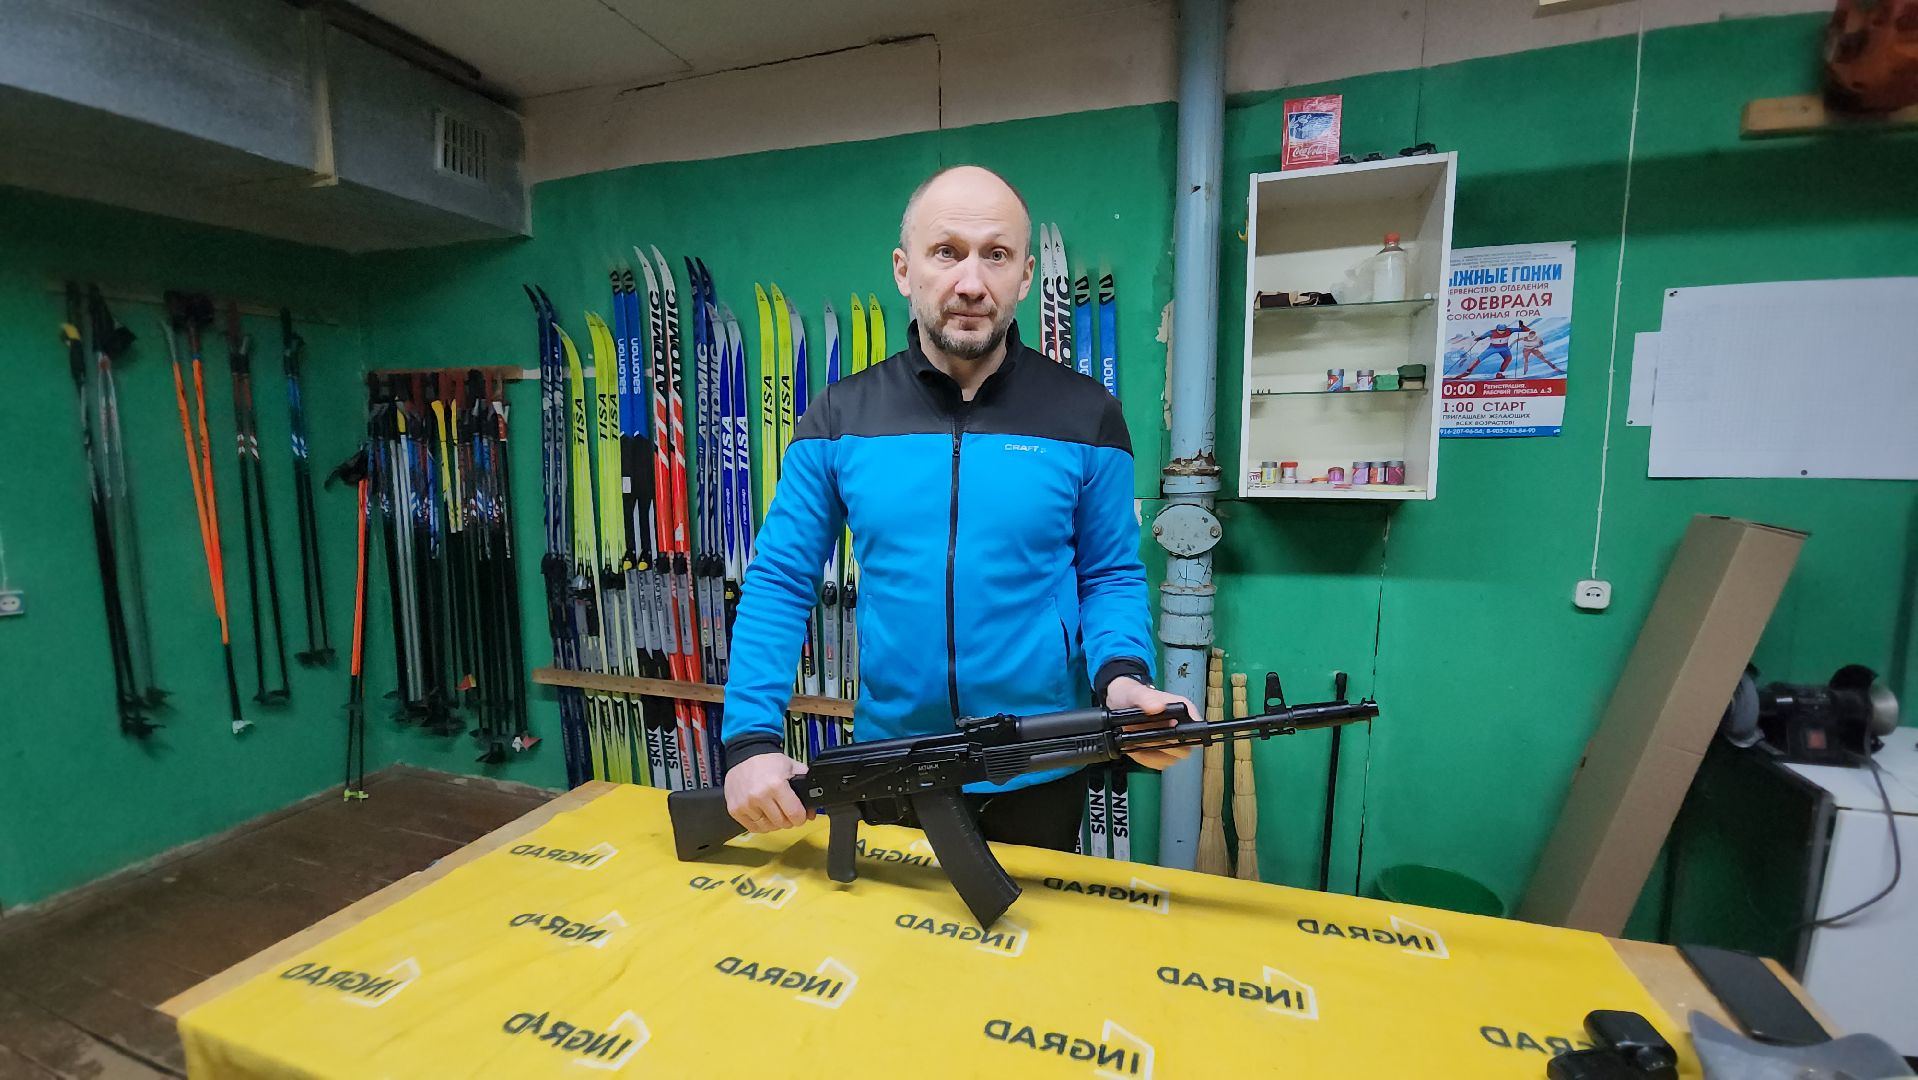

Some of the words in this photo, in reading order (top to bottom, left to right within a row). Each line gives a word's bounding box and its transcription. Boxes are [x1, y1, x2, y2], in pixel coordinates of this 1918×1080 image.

[1448, 286, 1496, 295] ЕРВЕНСТВО
[1500, 283, 1549, 293] ОТДЕЛЕНИЯ
[1449, 267, 1509, 287] ЫЖНЫЕ
[1512, 264, 1562, 283] ГОНКИ
[1043, 277, 1055, 358] OMIC
[1056, 275, 1071, 368] OMIC
[1447, 311, 1509, 321] СОКОЛИНАЯ
[1516, 309, 1540, 317] ГОРА
[1461, 292, 1552, 311] ФЕВРАЛЯ
[650, 289, 666, 396] ATOMIC
[665, 289, 682, 395] ATOMIC
[697, 342, 708, 441] ATOMIC
[763, 375, 773, 427] TISA
[781, 375, 791, 427] TISA
[1443, 383, 1476, 396] 0:00
[1443, 401, 1474, 412] 1:00
[1483, 401, 1526, 411] СТАРТ
[574, 398, 584, 445] TISA
[598, 393, 608, 440] TISA
[609, 394, 619, 441] TISA
[722, 416, 734, 471] TISA
[736, 416, 749, 471] TISA
[1004, 443, 1040, 452] CRAFT
[649, 732, 663, 768] SKIN
[665, 734, 679, 770] SKIN
[1090, 793, 1106, 835] SKIN
[1112, 796, 1128, 839] SKIN
